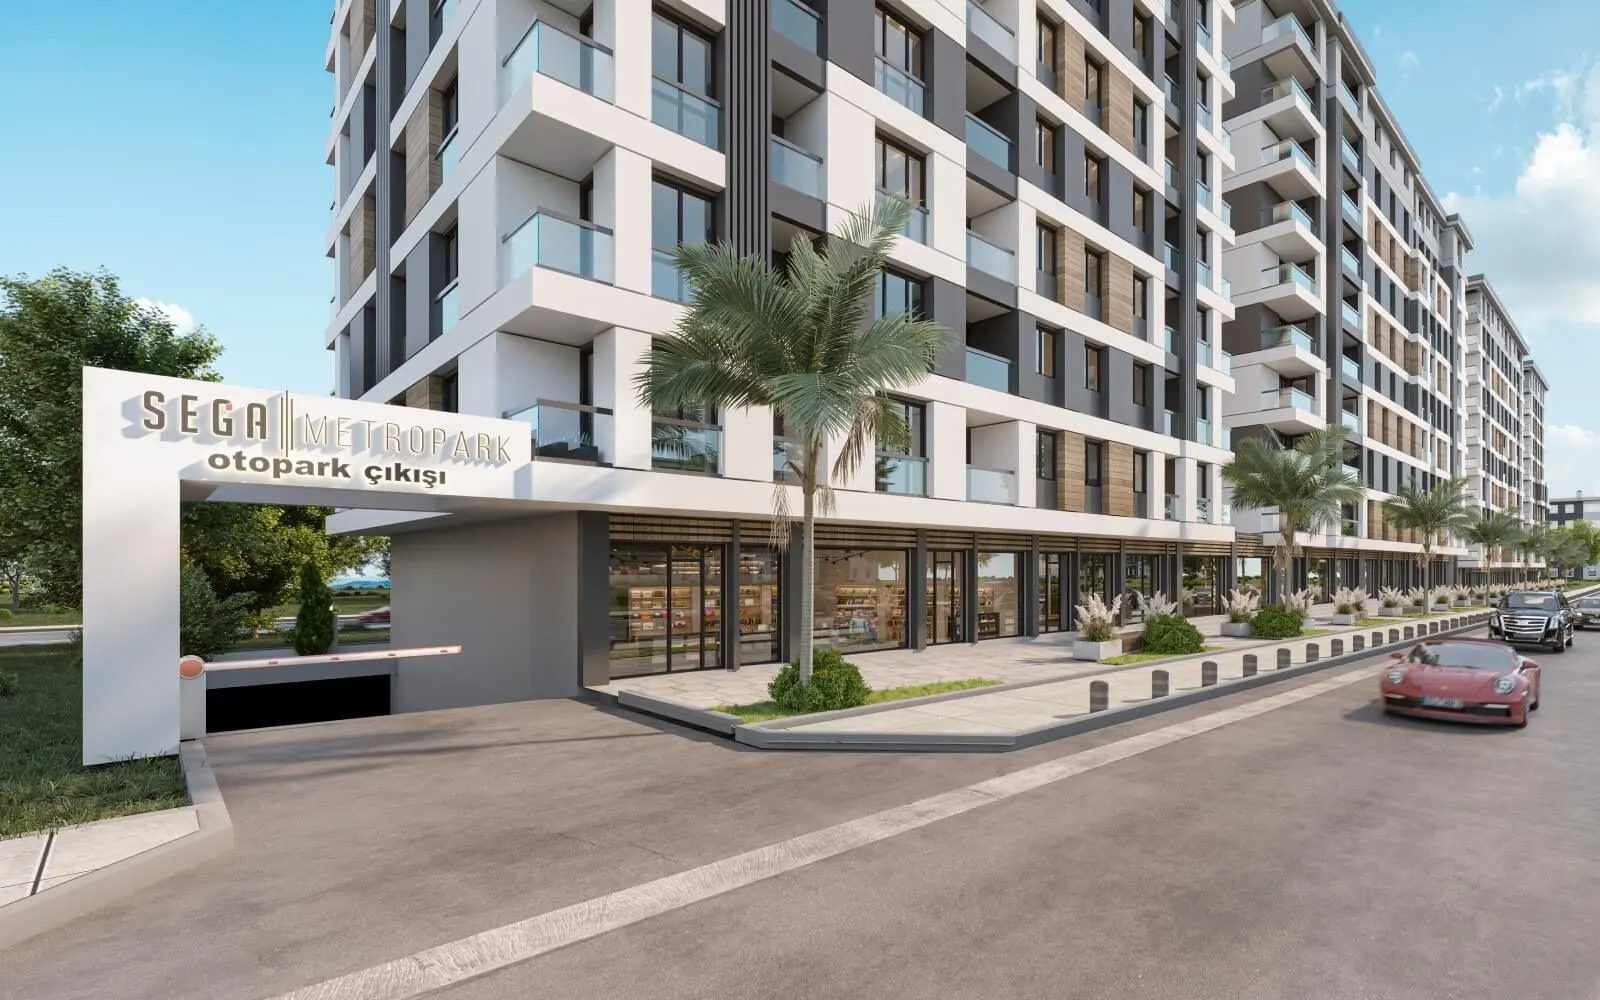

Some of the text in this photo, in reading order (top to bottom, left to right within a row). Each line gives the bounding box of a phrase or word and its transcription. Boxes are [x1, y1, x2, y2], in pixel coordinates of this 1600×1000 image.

[143, 391, 511, 462] SEGA METROPARK
[208, 451, 446, 488] otopark çıkışı
